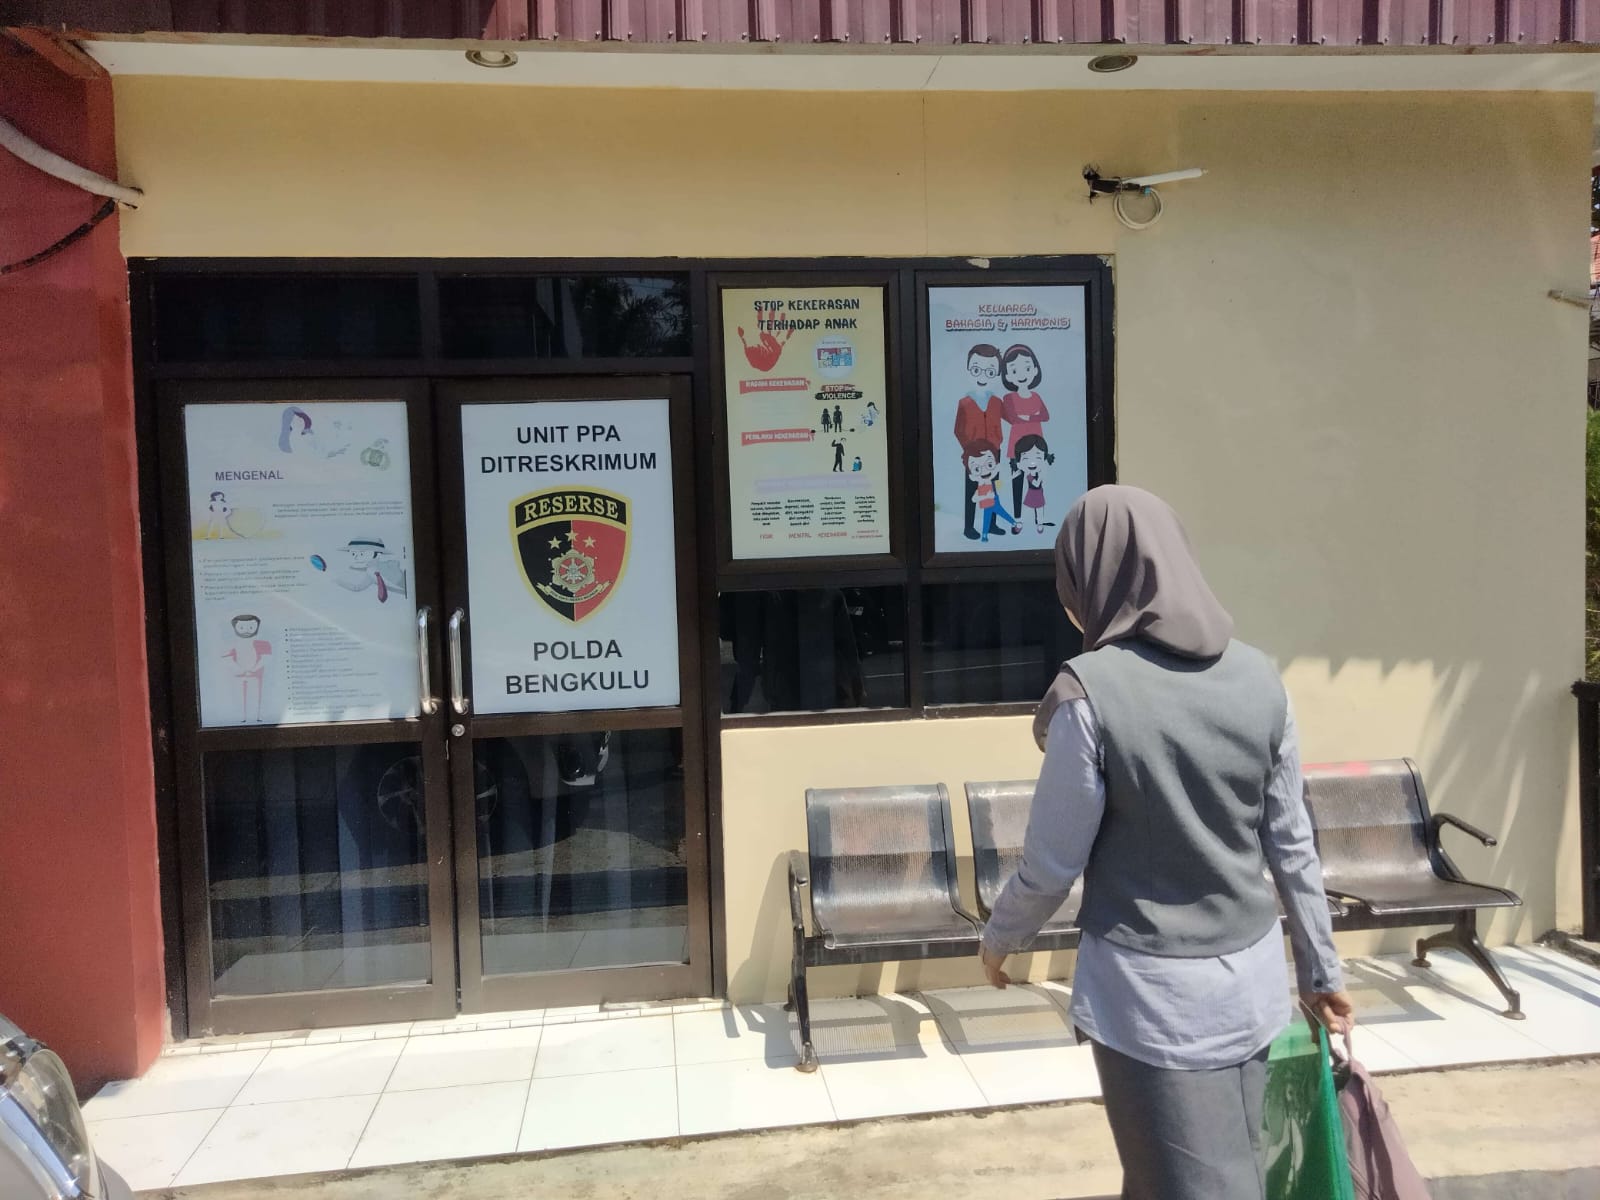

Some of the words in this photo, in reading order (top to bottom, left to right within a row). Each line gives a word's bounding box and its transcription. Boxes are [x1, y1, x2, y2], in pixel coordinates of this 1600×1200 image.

[754, 300, 785, 312] STOP
[788, 299, 860, 311] KEKERASAN
[978, 303, 1036, 315] KELUARGA
[759, 318, 820, 331] TERHADAP
[825, 318, 858, 330] ANAK
[945, 318, 993, 330] BAHAGIA
[1010, 317, 1069, 330] HARMONIS
[822, 392, 857, 400] VIOLENCE
[517, 425, 569, 444] UNIT
[577, 424, 621, 442] PPA
[481, 452, 657, 473] DITRESKRIMUM
[215, 470, 284, 481] MENGENAL
[523, 495, 620, 522] RESERSE
[533, 639, 623, 661] POLDA
[505, 669, 649, 694] BENGKULU
